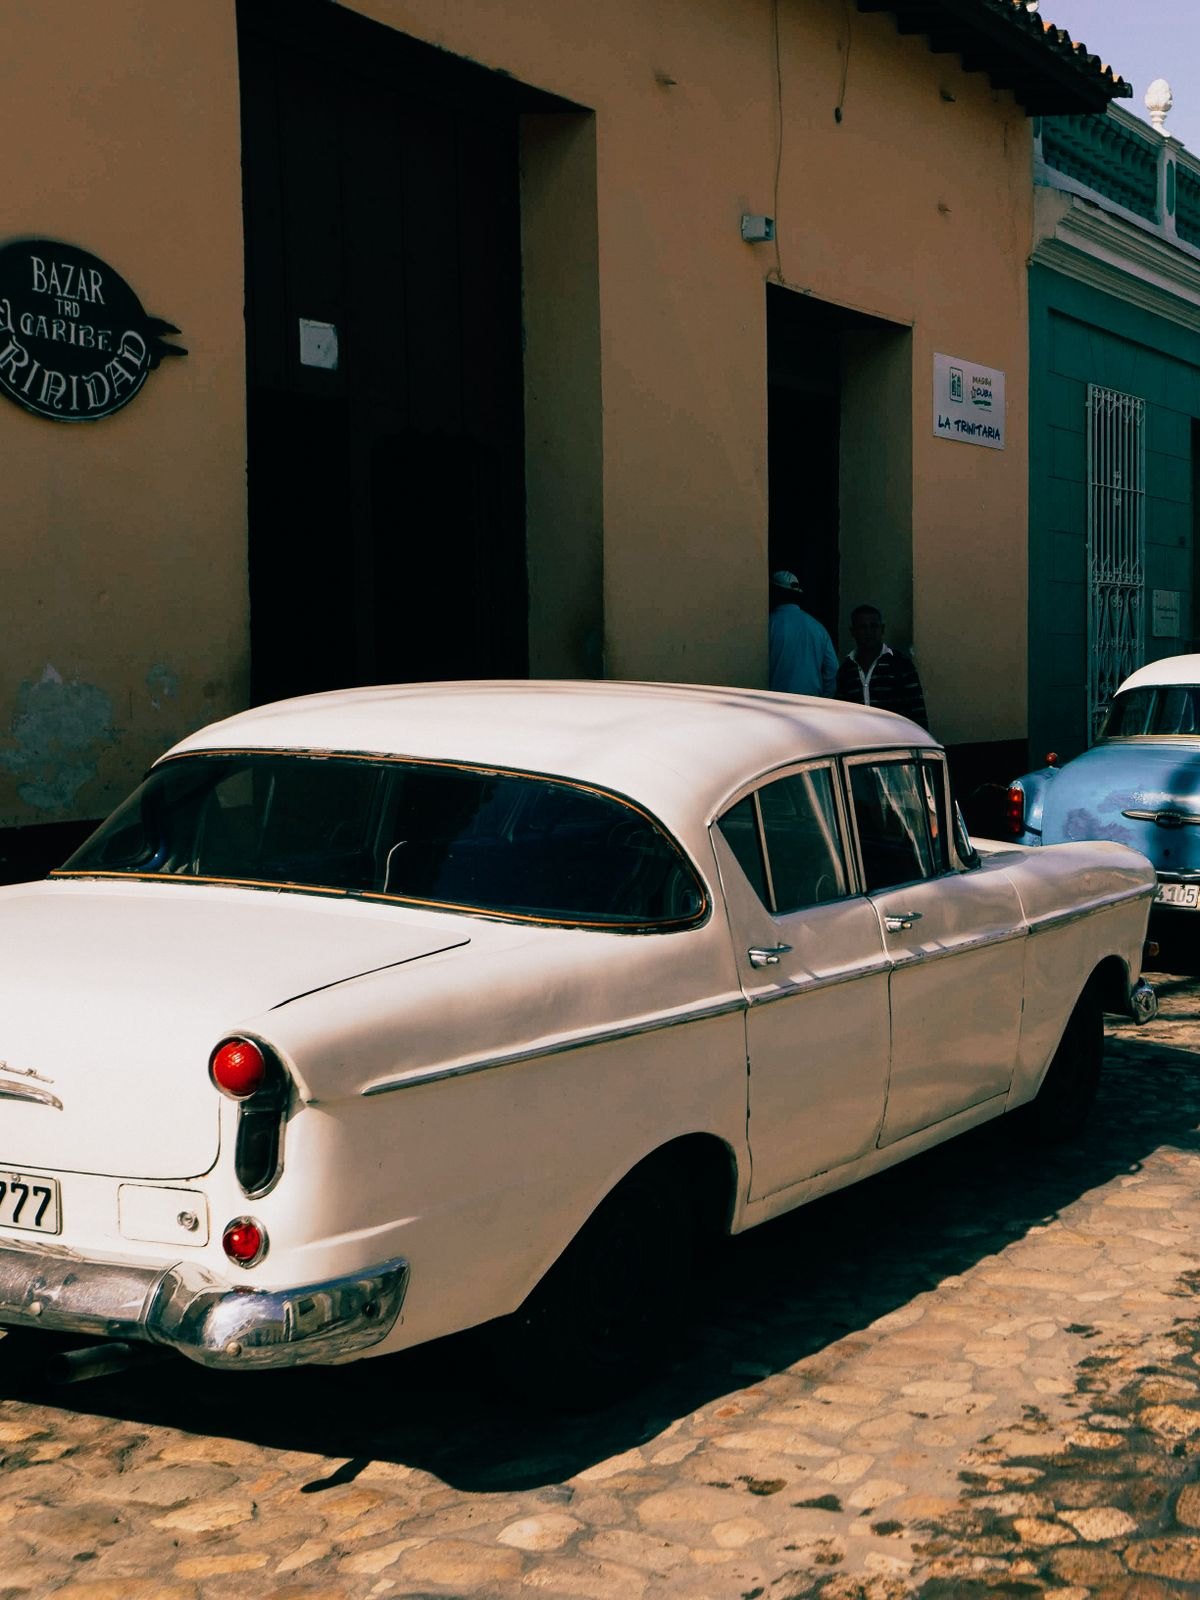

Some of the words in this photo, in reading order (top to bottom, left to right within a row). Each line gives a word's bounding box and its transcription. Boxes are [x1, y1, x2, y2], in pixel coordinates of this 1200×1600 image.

[31, 256, 105, 304] BAZAR
[54, 298, 80, 318] TRD
[20, 312, 112, 352] CARIBE
[938, 414, 951, 430] LA
[954, 419, 1000, 441] TRINITARIA
